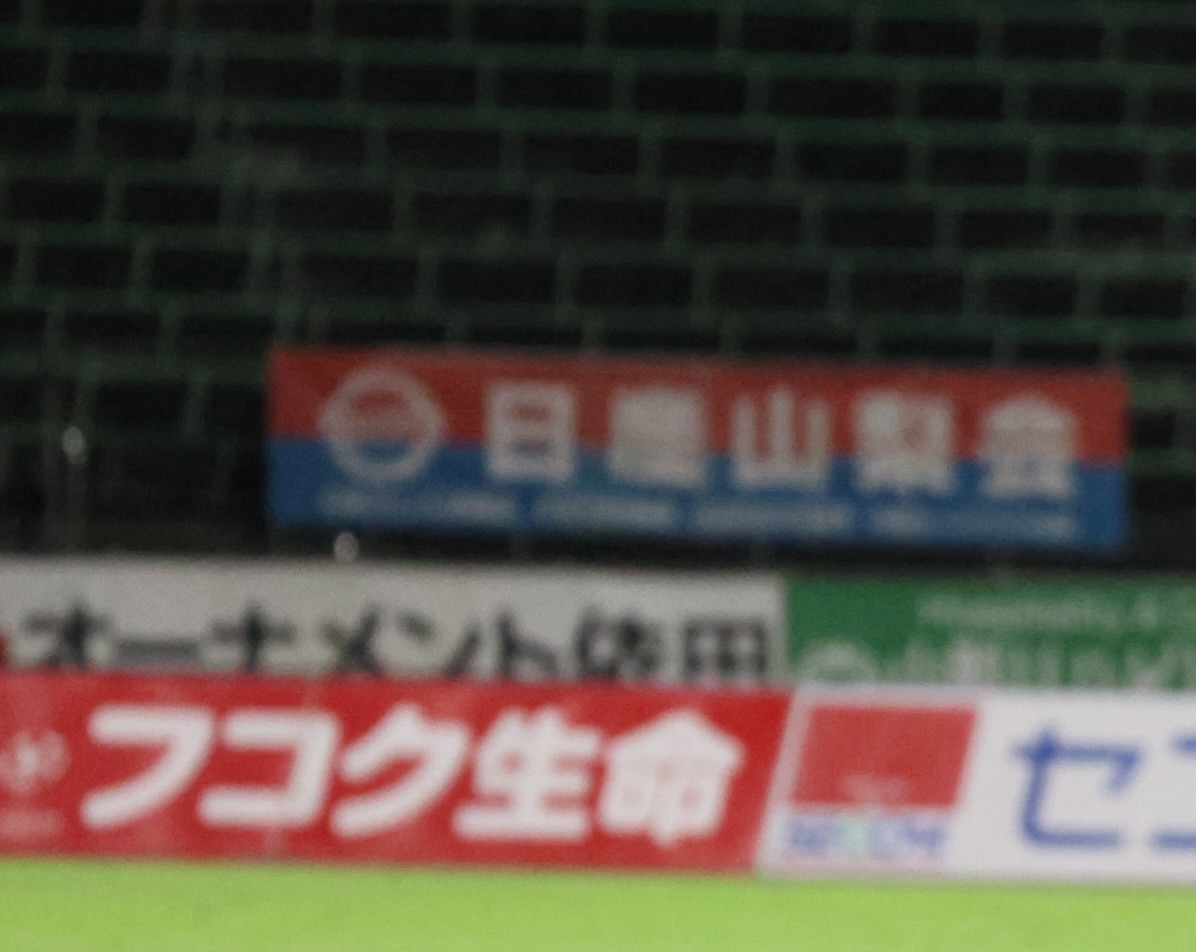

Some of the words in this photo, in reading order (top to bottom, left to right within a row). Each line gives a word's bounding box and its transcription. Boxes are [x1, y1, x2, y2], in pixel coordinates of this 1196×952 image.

[80, 702, 746, 848] フコク生命
